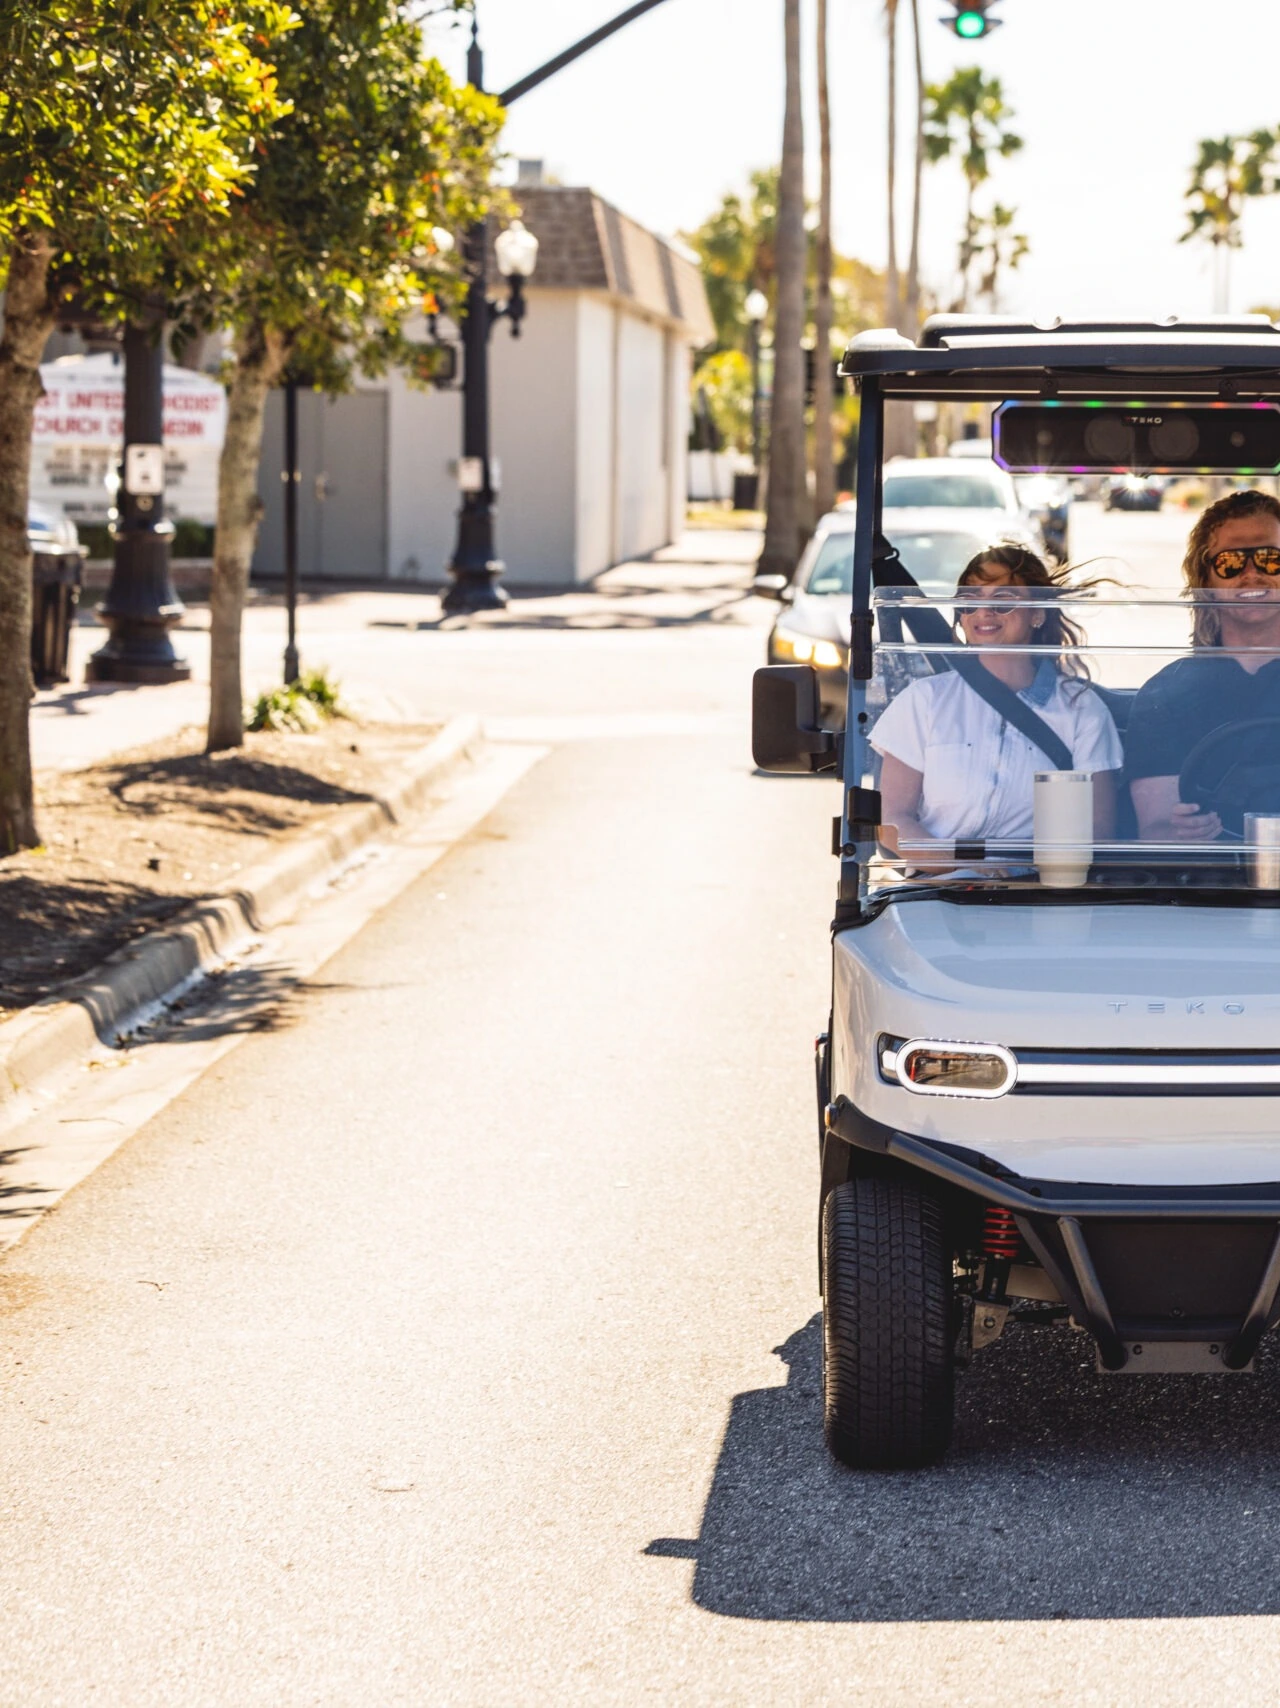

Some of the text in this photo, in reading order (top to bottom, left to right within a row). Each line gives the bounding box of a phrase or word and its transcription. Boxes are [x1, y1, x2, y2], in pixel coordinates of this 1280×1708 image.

[67, 391, 125, 409] UNITED
[163, 394, 218, 411] HODIST
[34, 416, 100, 434] CHURCH
[1131, 416, 1162, 424] TEKO
[1108, 1001, 1244, 1015] TEKO
